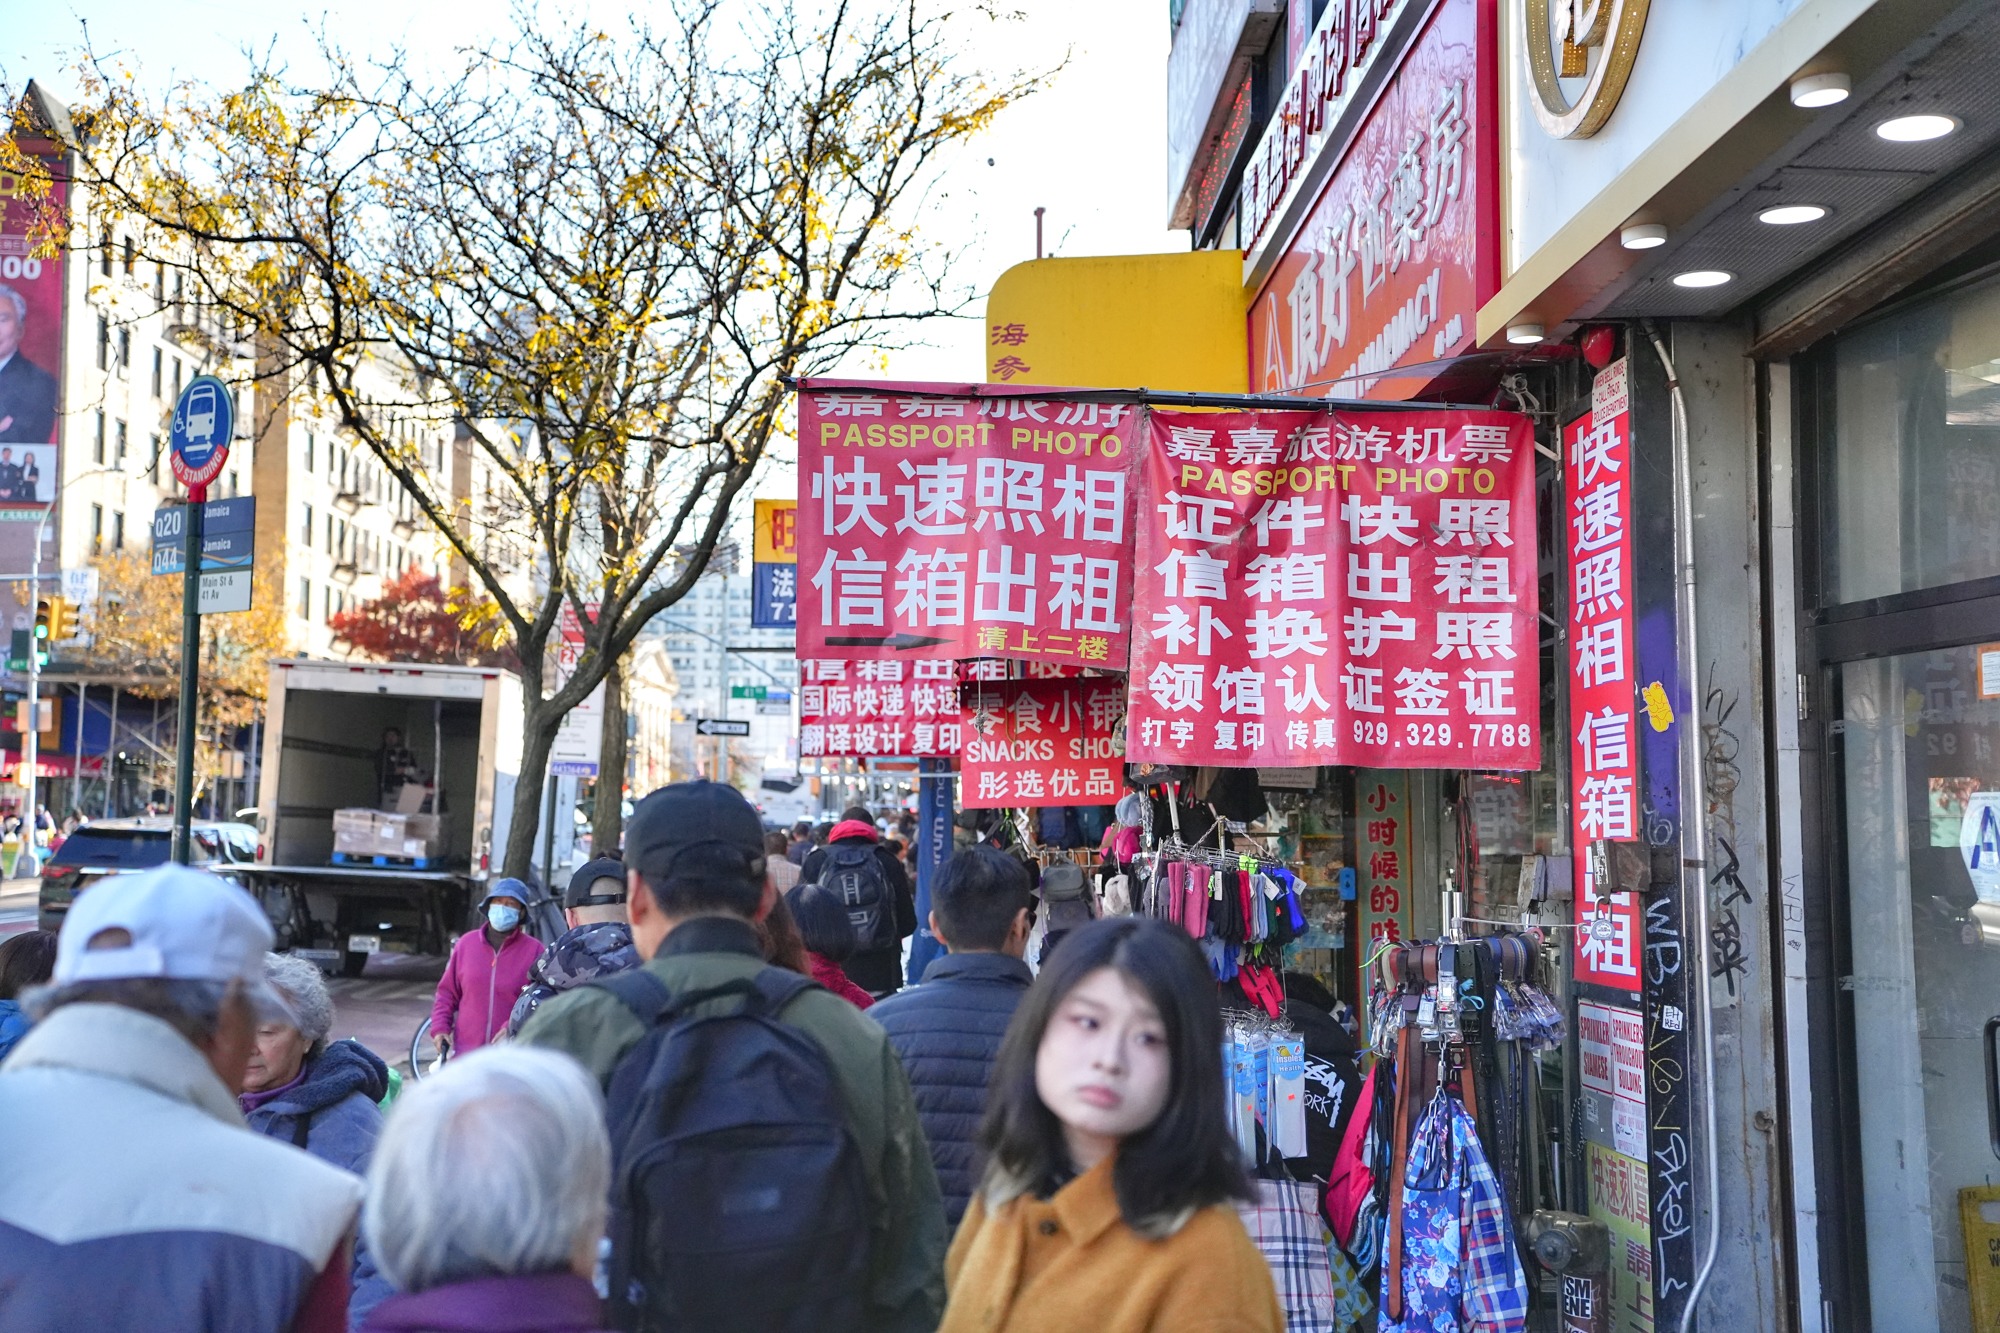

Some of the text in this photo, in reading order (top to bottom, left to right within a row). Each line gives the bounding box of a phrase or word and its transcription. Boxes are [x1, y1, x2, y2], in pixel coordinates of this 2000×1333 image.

[820, 422, 1122, 458] PASSPORT PHOTO
[1165, 423, 1513, 465] 嘉嘉旅游机票
[172, 454, 184, 474] NO
[183, 451, 222, 484] STANDING
[1180, 465, 1496, 497] PASSPORT PHOTO
[204, 504, 230, 519] Jamaica
[811, 455, 1126, 544] 快速照相
[156, 510, 181, 538] Q20
[1157, 490, 1515, 549] 证件快照
[154, 547, 178, 573] Q44
[203, 537, 231, 553] Jamaica
[1571, 421, 1625, 689] 快速照相
[202, 575, 233, 588] Main St &
[811, 544, 1121, 634] 信箱出租
[1154, 548, 1517, 604] 信箱出租
[202, 590, 220, 600] 41 Av
[977, 627, 1109, 660] 请上二楼
[1151, 605, 1517, 660] 补换护照
[801, 683, 905, 718] 国际快递
[1148, 661, 1517, 717] 领馆认证签证
[966, 688, 1124, 737] 零食小铺
[801, 722, 962, 756] 翻译设计 复印
[966, 737, 1116, 763] SNACKS SHO
[1141, 717, 1532, 751] 打字 复印 传真 929.329.7788
[978, 767, 1115, 800] 彤选优品
[1367, 783, 1401, 943] 小时候的味
[1580, 1016, 1610, 1045] SPRINKLER
[1612, 1018, 1644, 1045] SPRINKLERS
[1276, 1054, 1303, 1063] Insoles
[1583, 1051, 1609, 1081] SIAMESE
[1612, 1043, 1645, 1070] THROUGHOUT
[1618, 1068, 1642, 1095] BUILDING
[1591, 1146, 1651, 1230] 快速刻章
